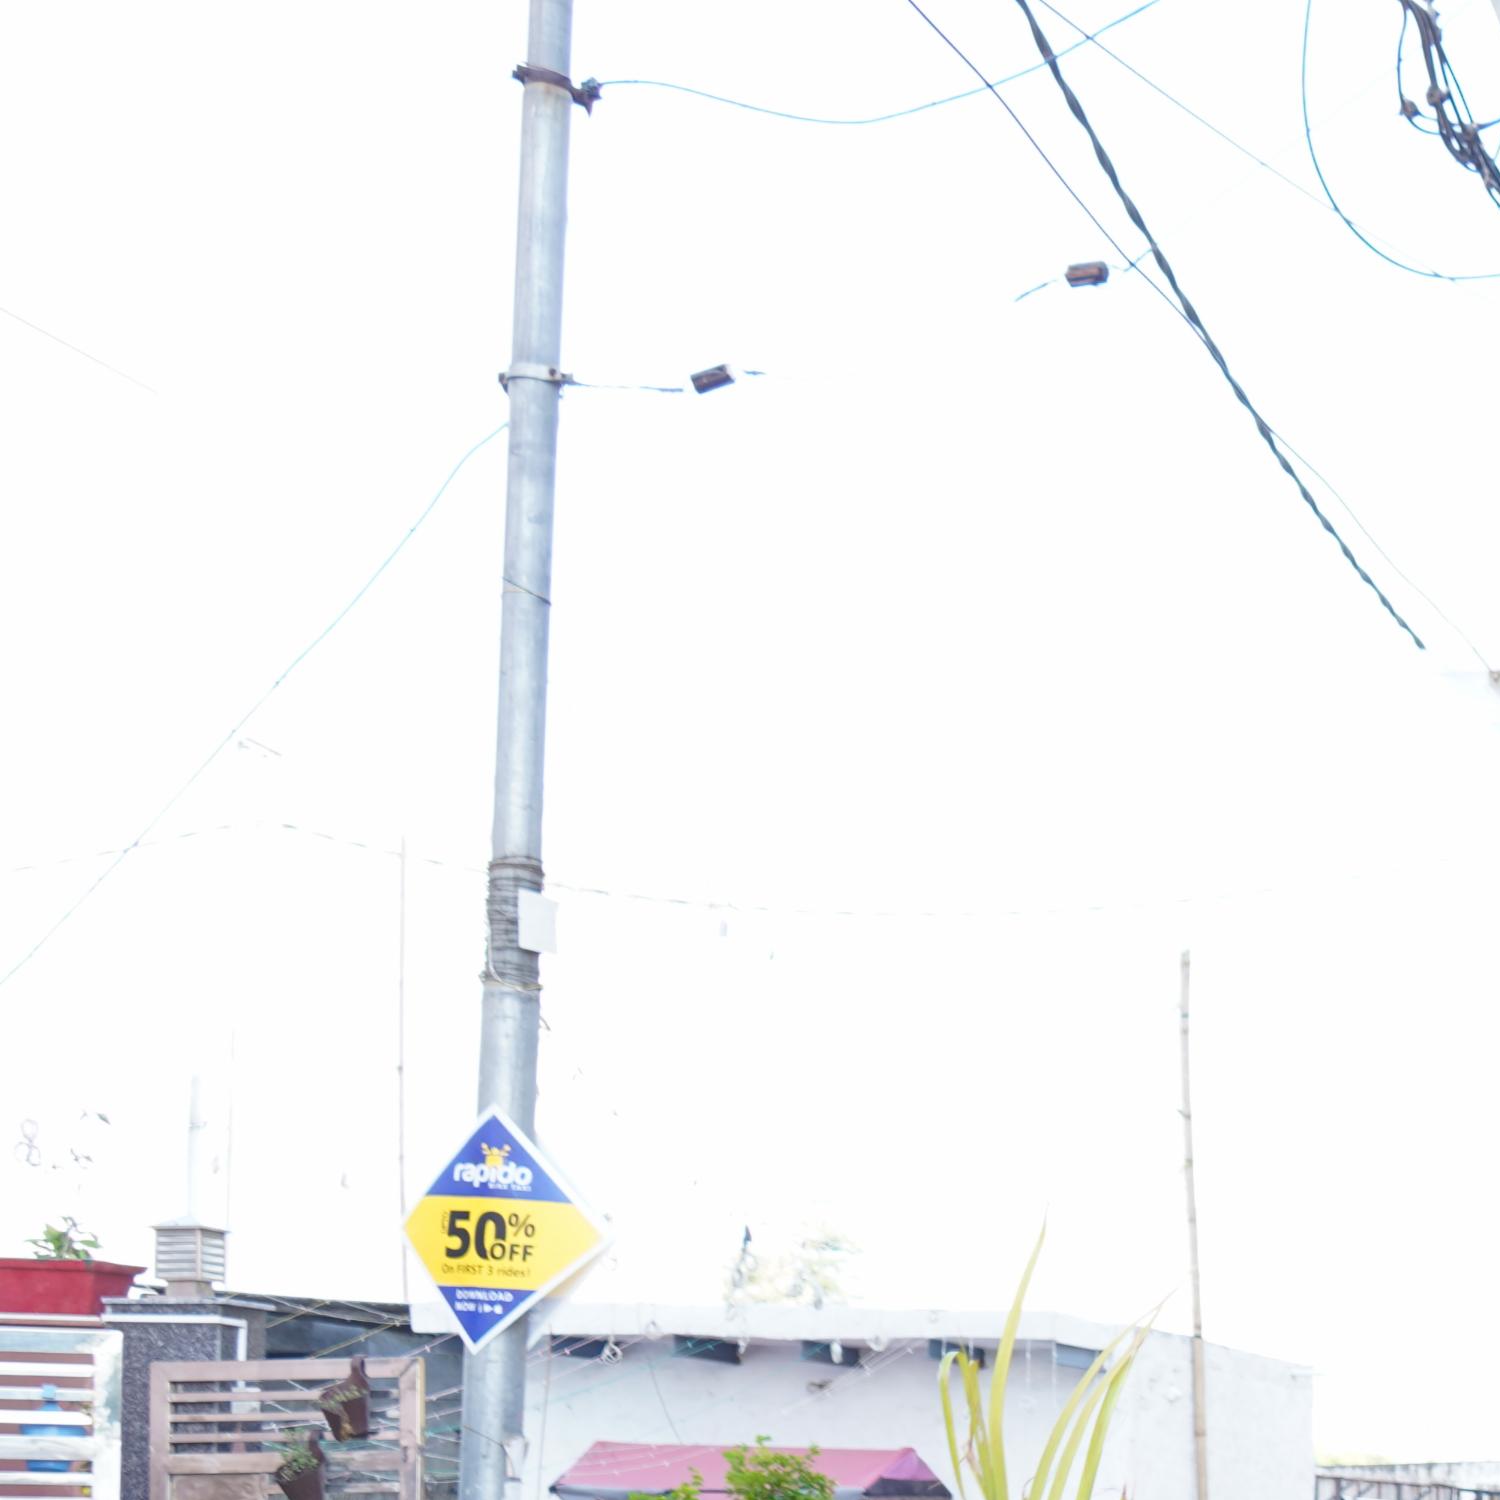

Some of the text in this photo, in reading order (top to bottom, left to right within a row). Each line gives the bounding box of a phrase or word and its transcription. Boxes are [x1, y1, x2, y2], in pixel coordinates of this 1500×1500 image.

[453, 1161, 534, 1188] rapido
[490, 1242, 534, 1262] OFF
[457, 1264, 483, 1275] FIRST
[487, 1265, 493, 1276] 3
[455, 1288, 514, 1303] DOWNLOAD
